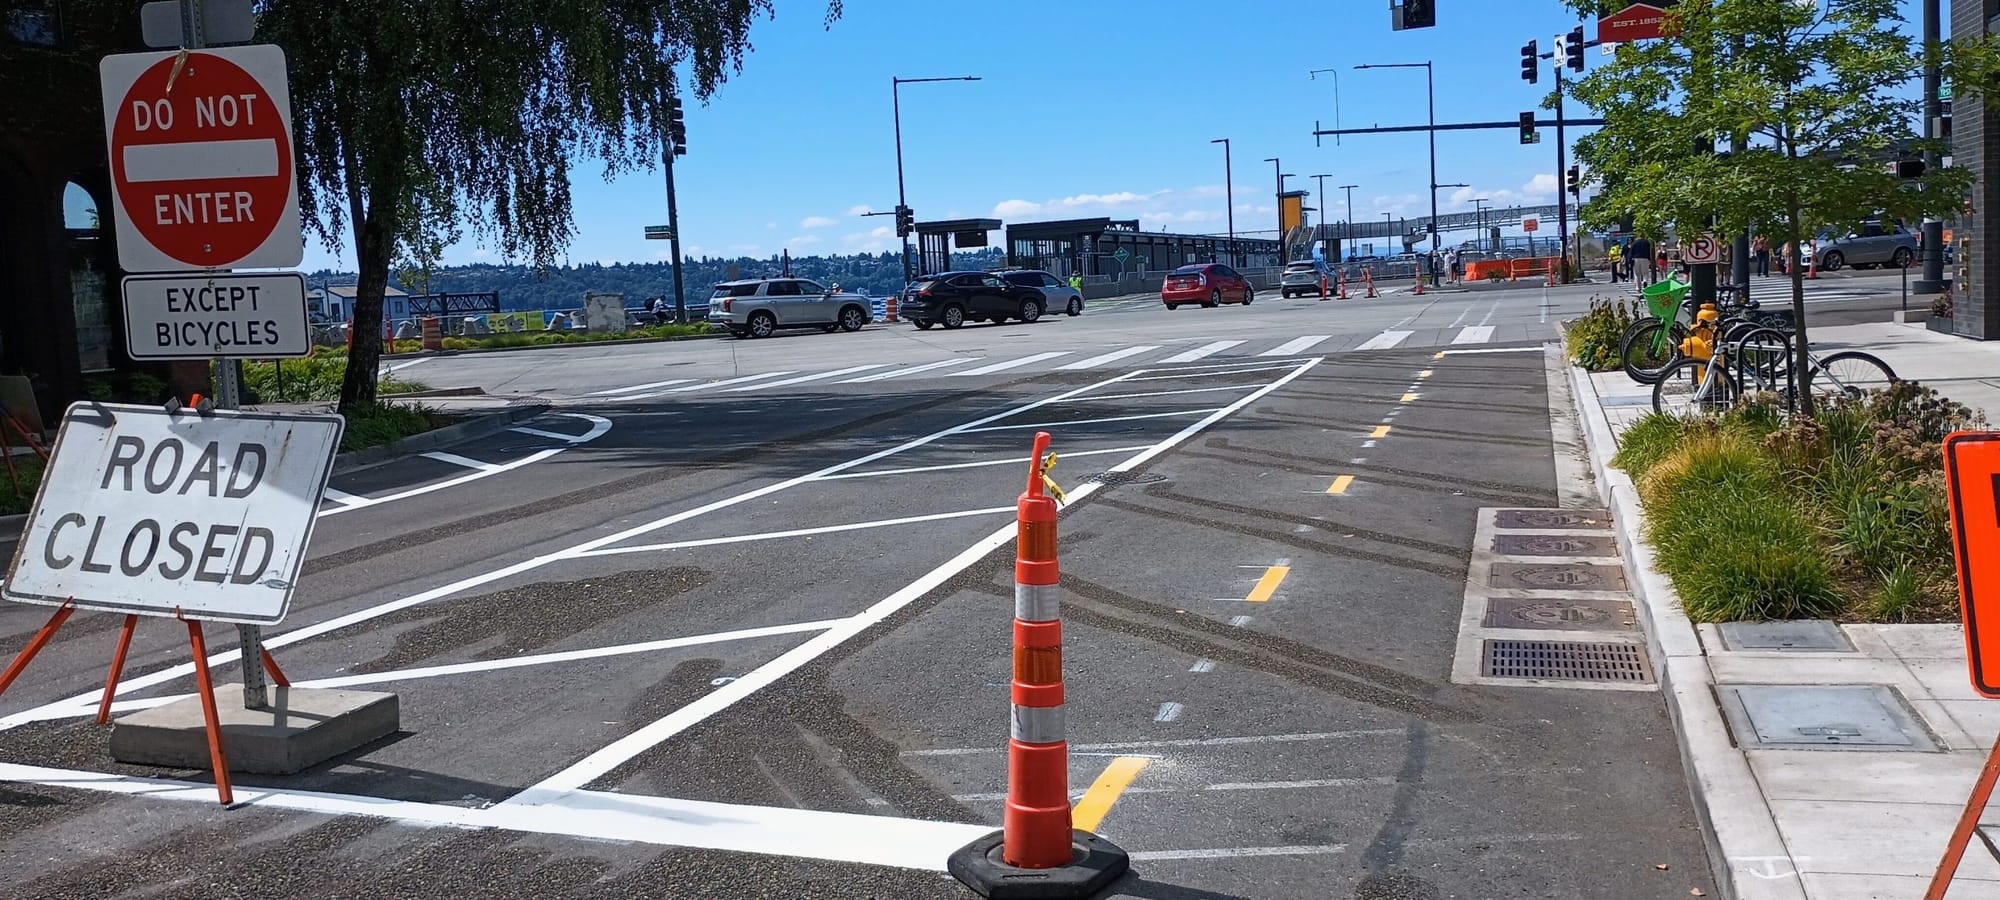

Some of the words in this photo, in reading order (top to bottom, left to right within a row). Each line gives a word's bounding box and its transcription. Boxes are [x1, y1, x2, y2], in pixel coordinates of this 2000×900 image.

[133, 99, 174, 132] DO
[195, 93, 257, 128] NOT
[154, 191, 255, 226] ENTER
[166, 285, 260, 313] EXCEPT
[156, 318, 280, 348] BICYCLES
[101, 435, 267, 499] ROAD
[44, 512, 275, 585] CLOSED
